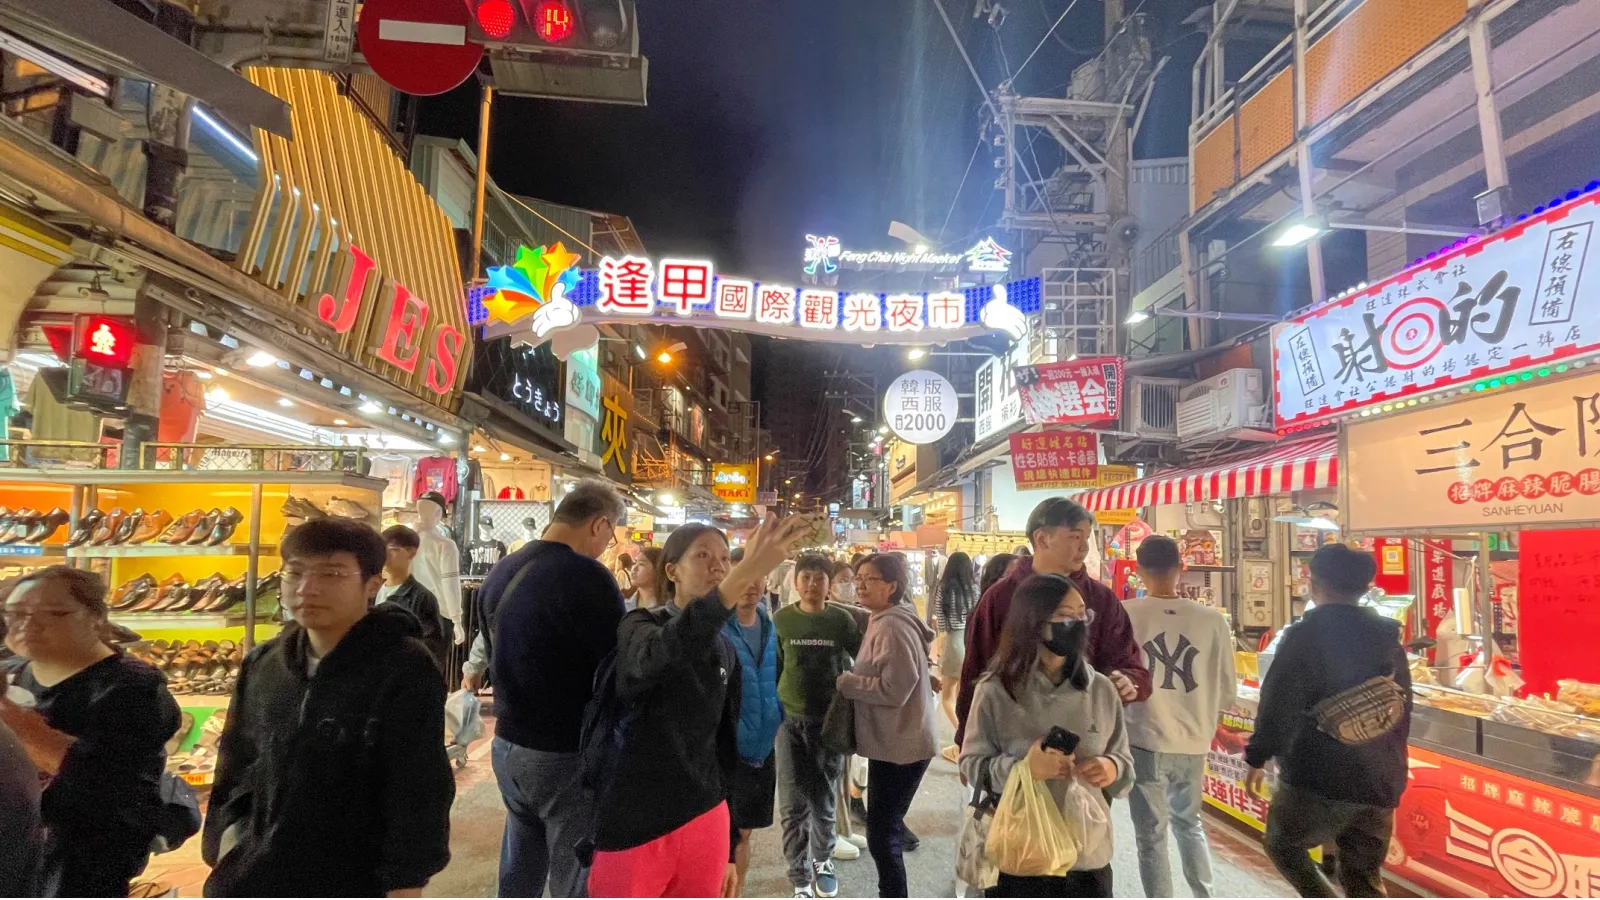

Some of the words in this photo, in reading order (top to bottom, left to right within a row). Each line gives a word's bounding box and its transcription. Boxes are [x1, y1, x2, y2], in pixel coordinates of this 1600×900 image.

[545, 9, 569, 35] 14
[838, 250, 867, 263] Feng
[867, 250, 892, 263] Chia
[893, 250, 920, 264] Night
[1543, 230, 1579, 319] 右線預備
[602, 259, 961, 327] 逢甲國際觀光夜市
[318, 243, 465, 394] JES
[901, 379, 942, 395] 韓版
[1296, 337, 1319, 389] 左線預備
[512, 373, 560, 422] とうきょう
[901, 396, 942, 411] 西服
[1103, 364, 1117, 416] 開催中
[601, 395, 628, 474] 夾
[1452, 471, 1600, 502] 招牌麻辣脆腸
[1482, 502, 1563, 517] SANHEYUAN
[790, 638, 834, 647] HANDSOME
[1142, 631, 1200, 693] NY
